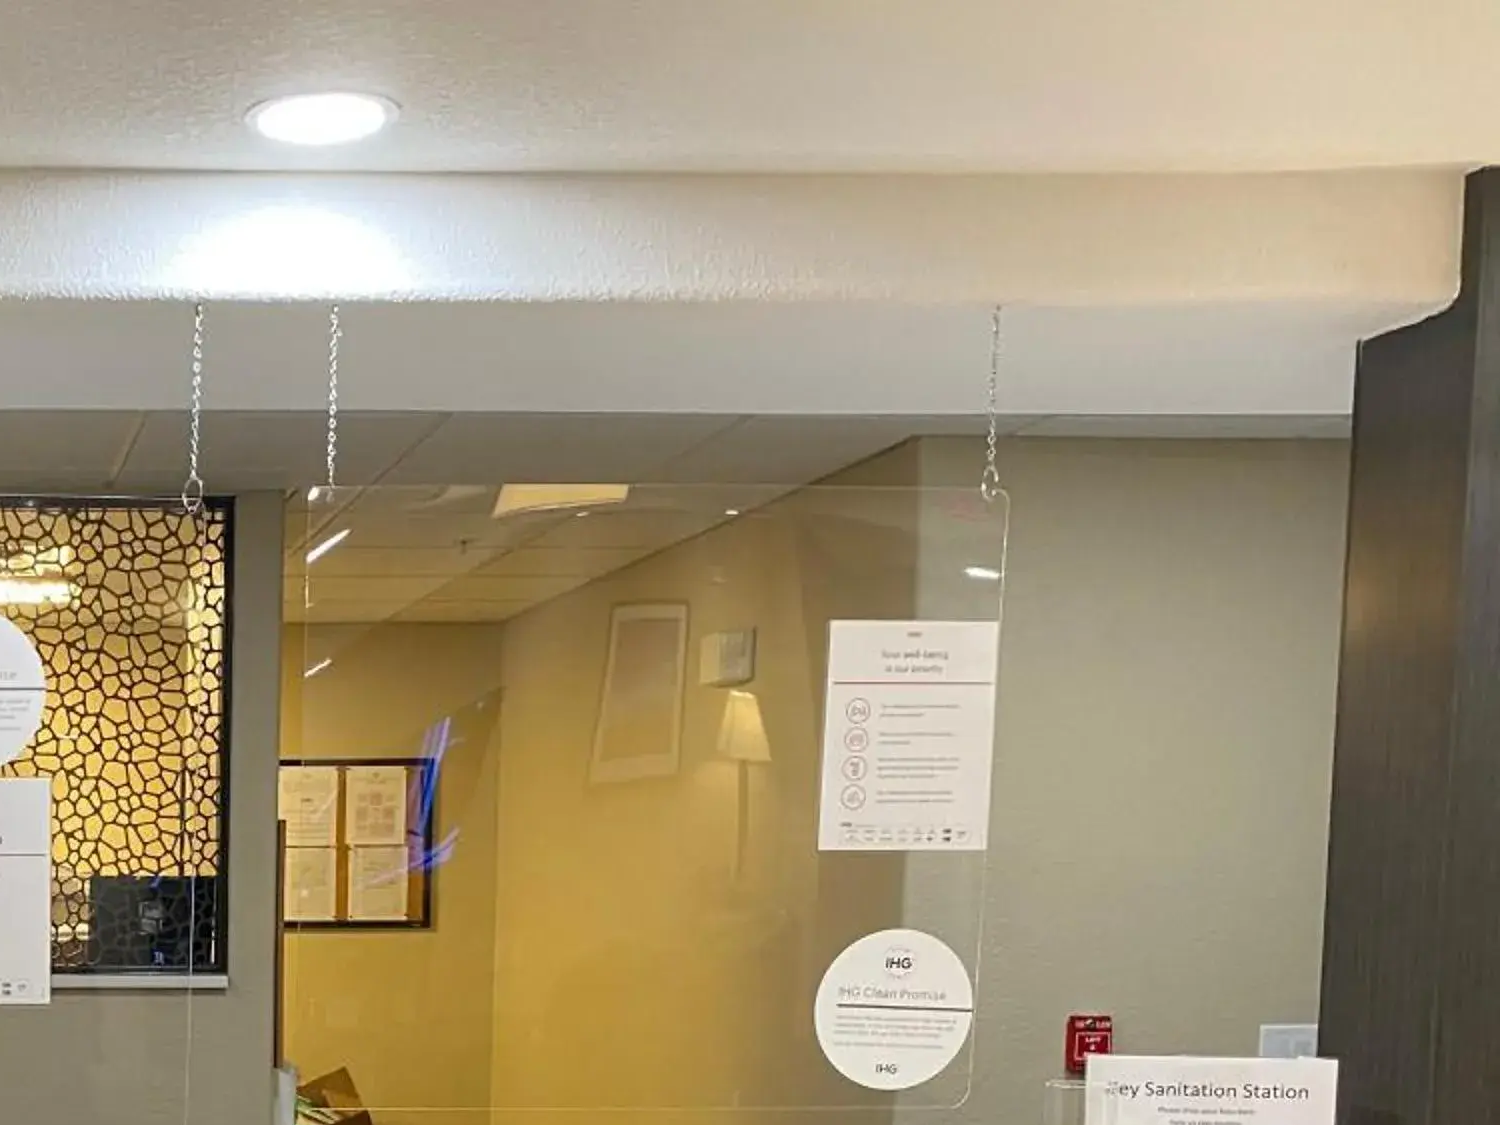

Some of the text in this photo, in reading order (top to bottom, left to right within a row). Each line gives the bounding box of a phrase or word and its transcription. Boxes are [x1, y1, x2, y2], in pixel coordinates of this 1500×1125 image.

[885, 957, 912, 969] IHG
[838, 986, 947, 1000] IHG Clean Promise
[875, 1063, 898, 1074] IHG
[1145, 1081, 1237, 1099] Sanitation
[1243, 1083, 1310, 1100] Station
